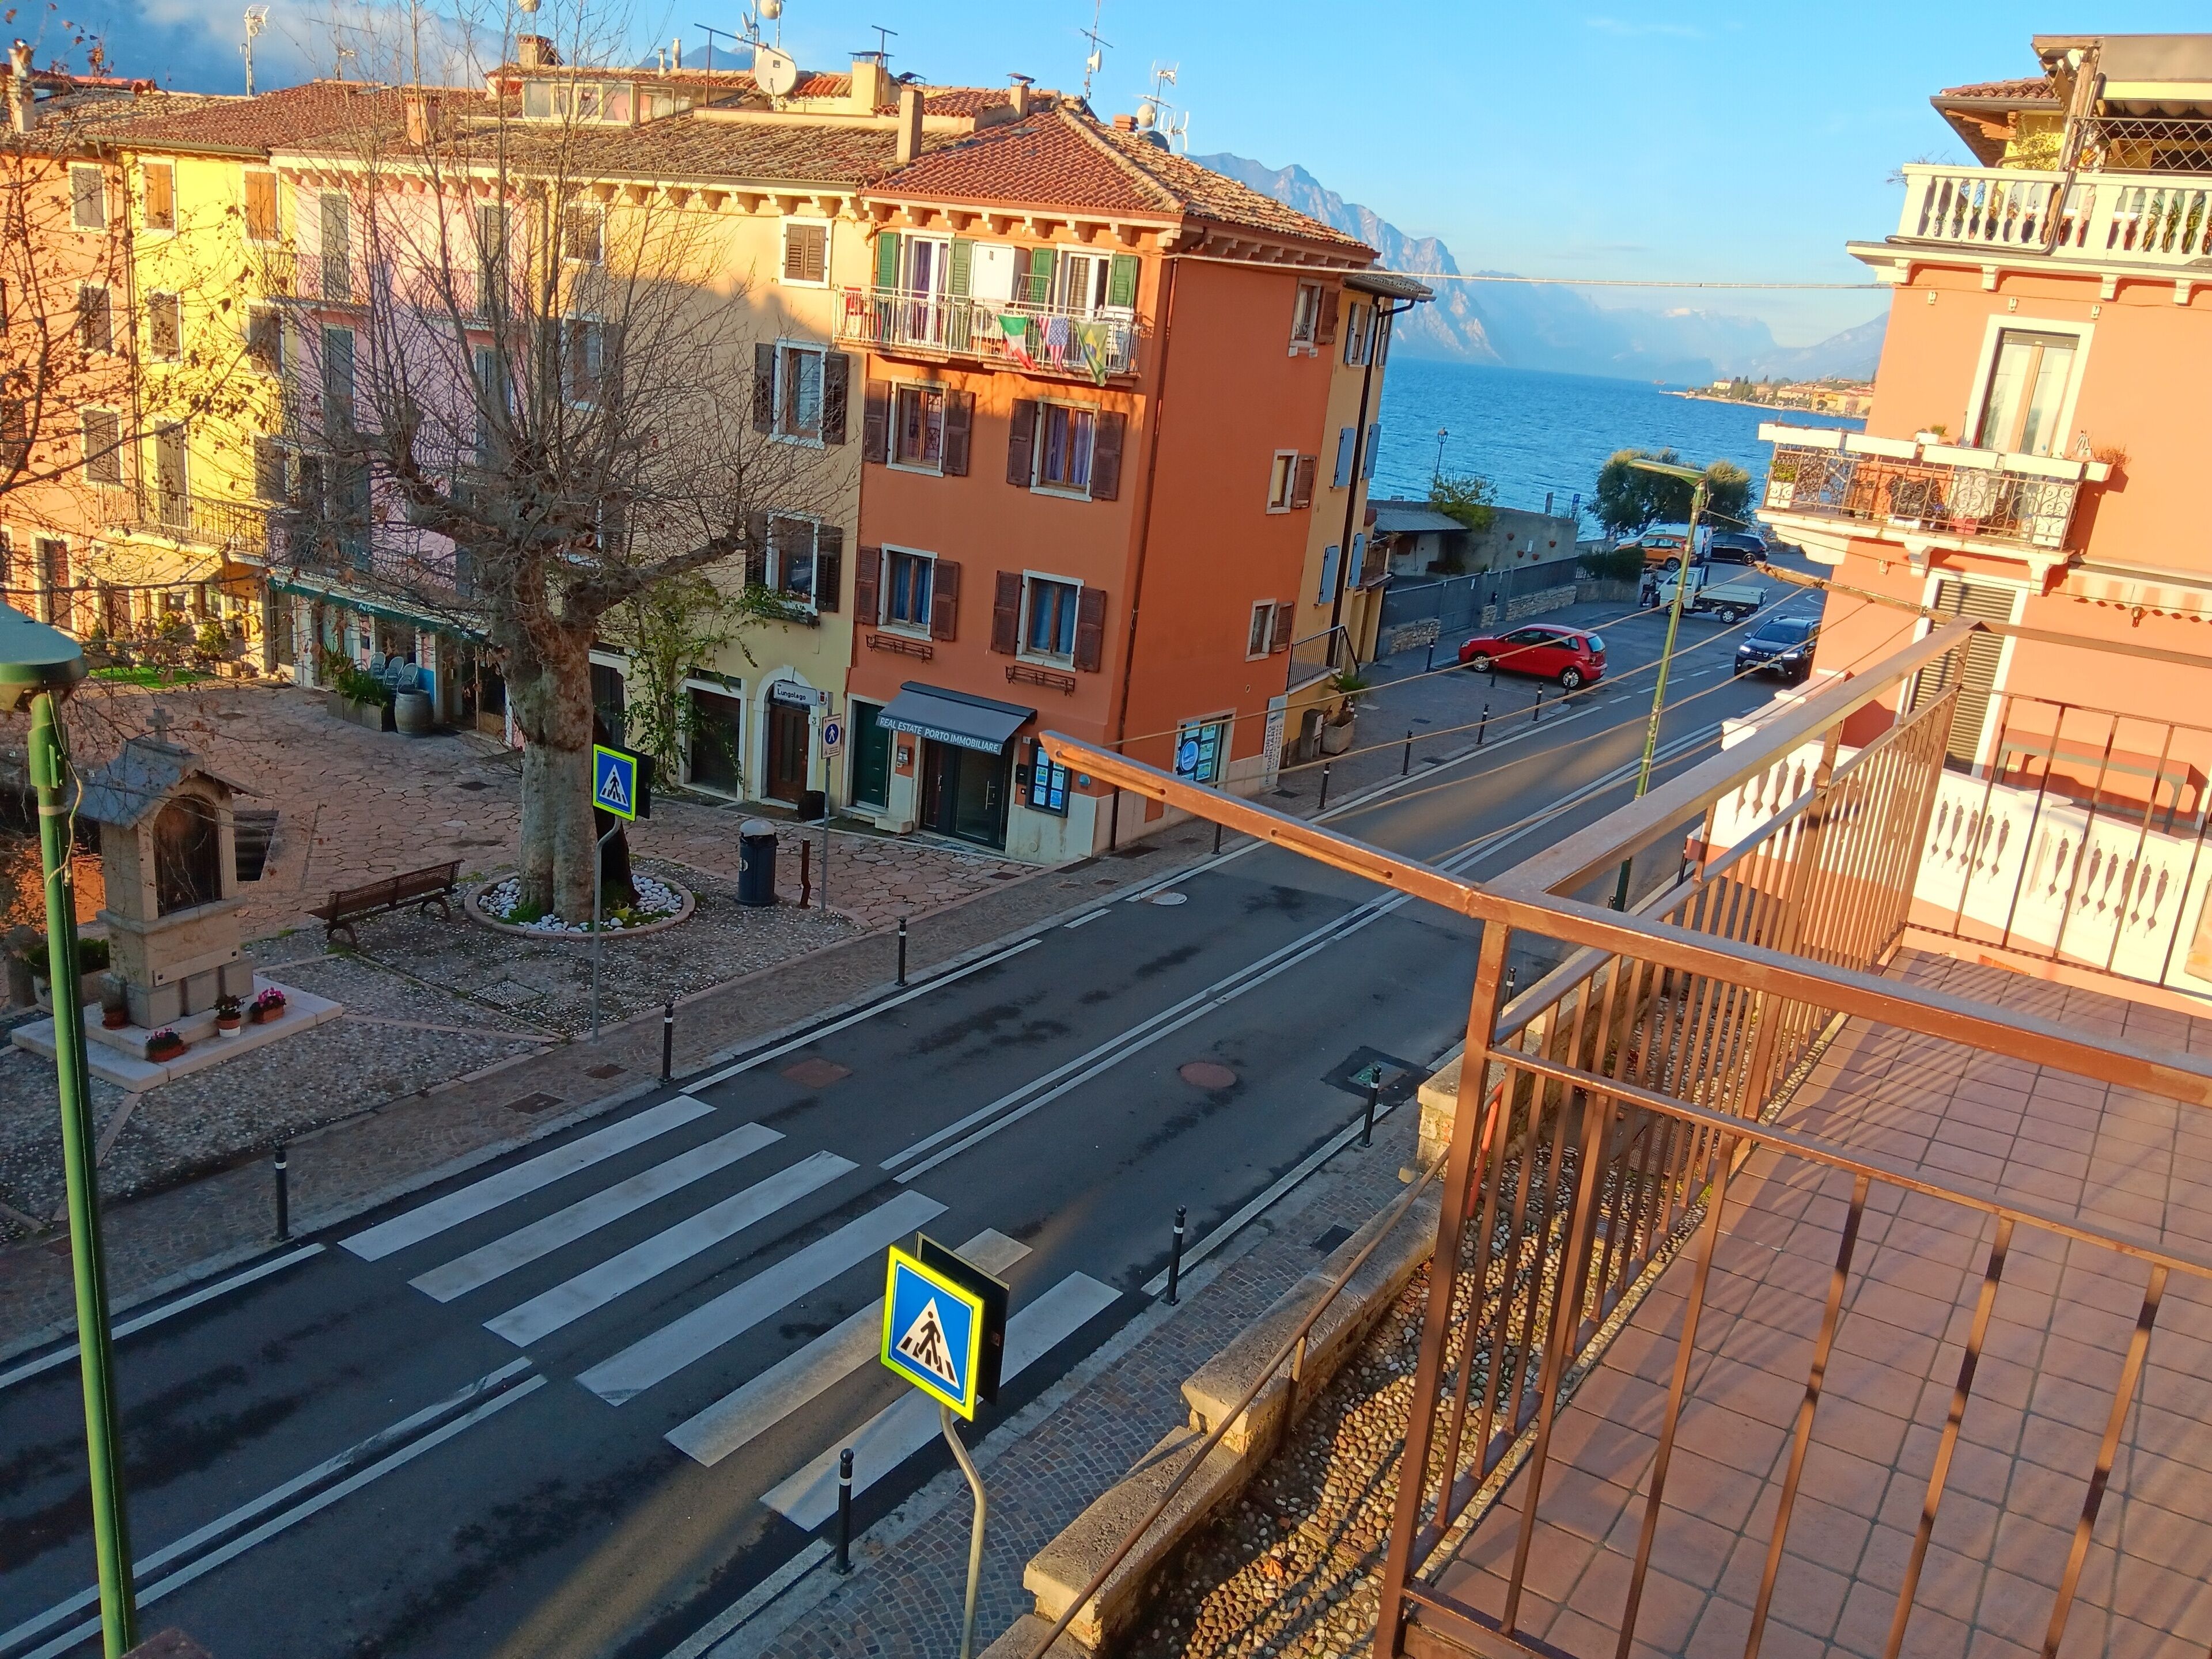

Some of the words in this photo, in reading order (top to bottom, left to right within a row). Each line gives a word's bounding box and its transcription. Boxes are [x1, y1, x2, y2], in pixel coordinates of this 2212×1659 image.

[777, 688, 806, 700] Lungolago
[812, 717, 817, 725] 3
[880, 717, 896, 729] REAL
[897, 721, 922, 735] ESTATE
[925, 728, 949, 741] PORTO
[950, 734, 999, 753] IMMOBILIARE
[1264, 726, 1272, 758] PORTO
